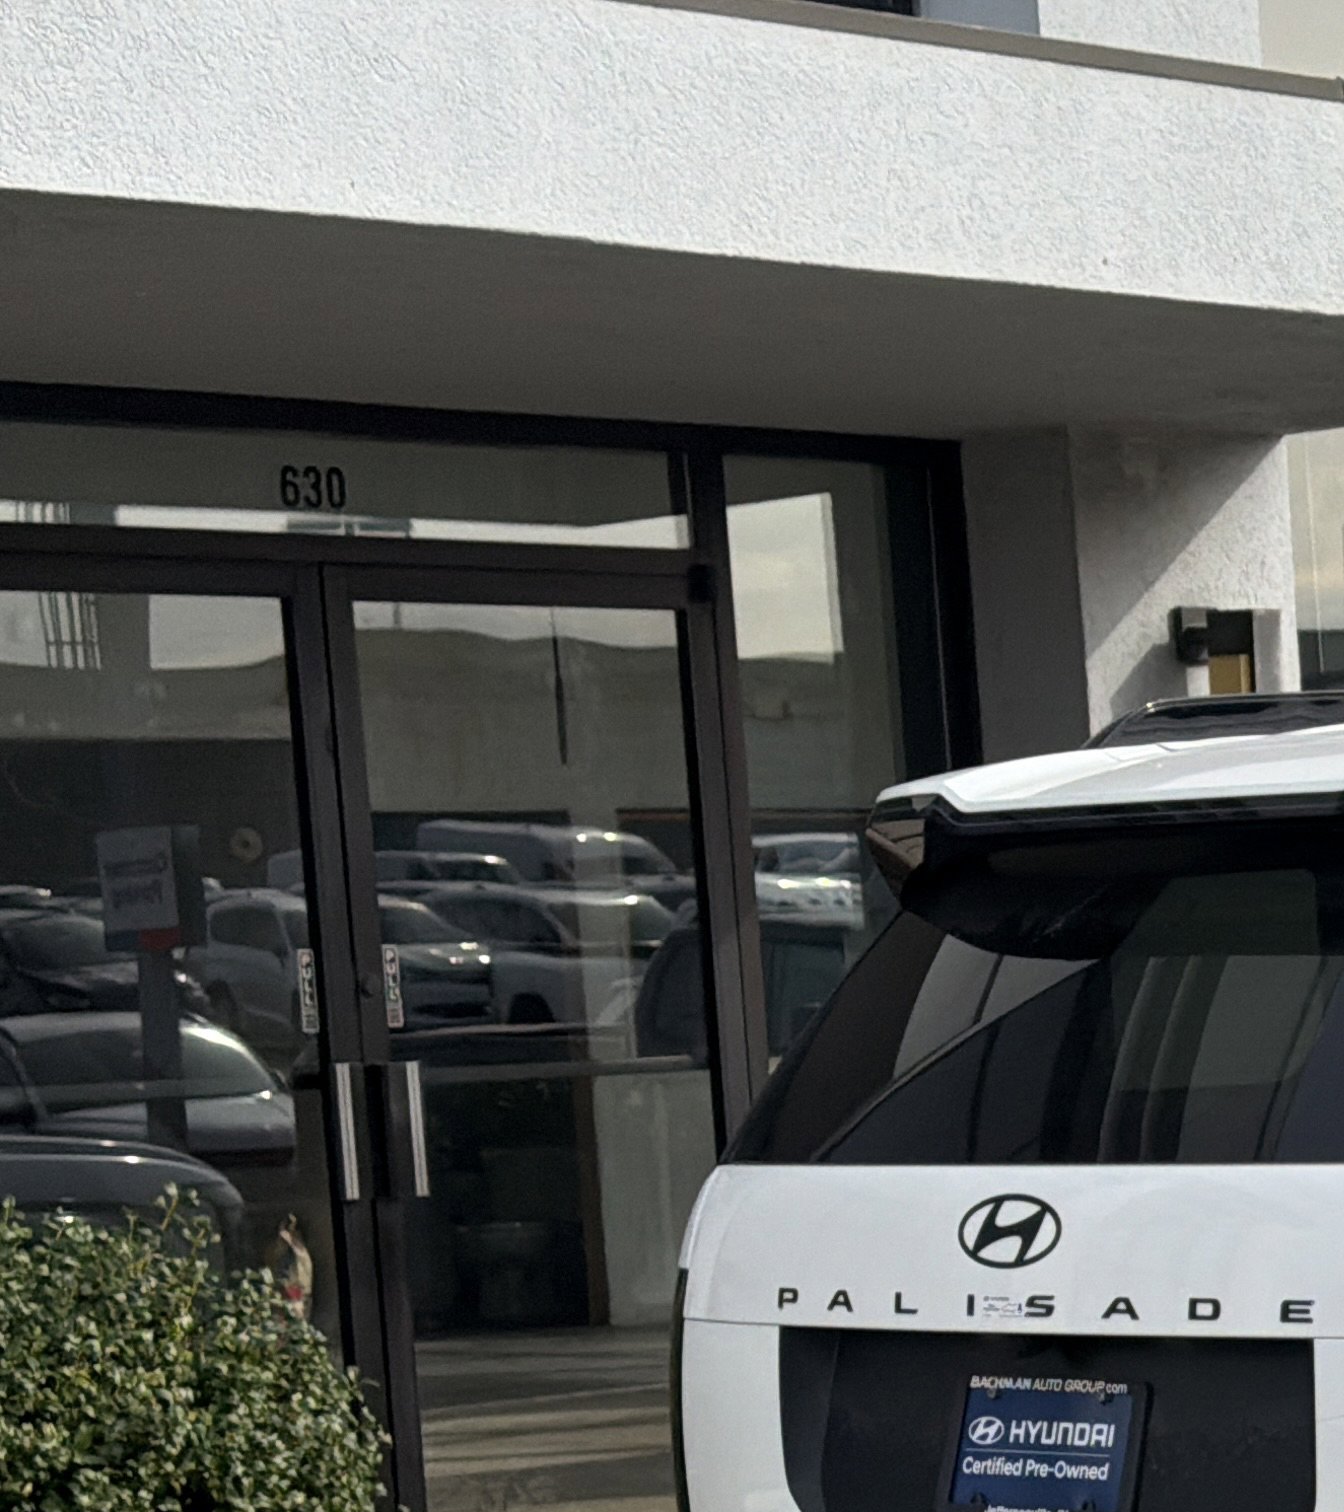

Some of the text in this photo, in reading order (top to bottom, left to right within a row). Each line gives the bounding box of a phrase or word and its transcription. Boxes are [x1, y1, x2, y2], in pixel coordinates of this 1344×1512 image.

[281, 465, 346, 508] 630
[301, 951, 316, 1007] PULL
[778, 1287, 1315, 1325] PALISADE
[970, 1375, 1032, 1391] BACHMAN
[1033, 1378, 1062, 1392] AUTO
[1009, 1419, 1116, 1448] HYUNDAI
[962, 1456, 1110, 1481] Certified Pre-Owned
